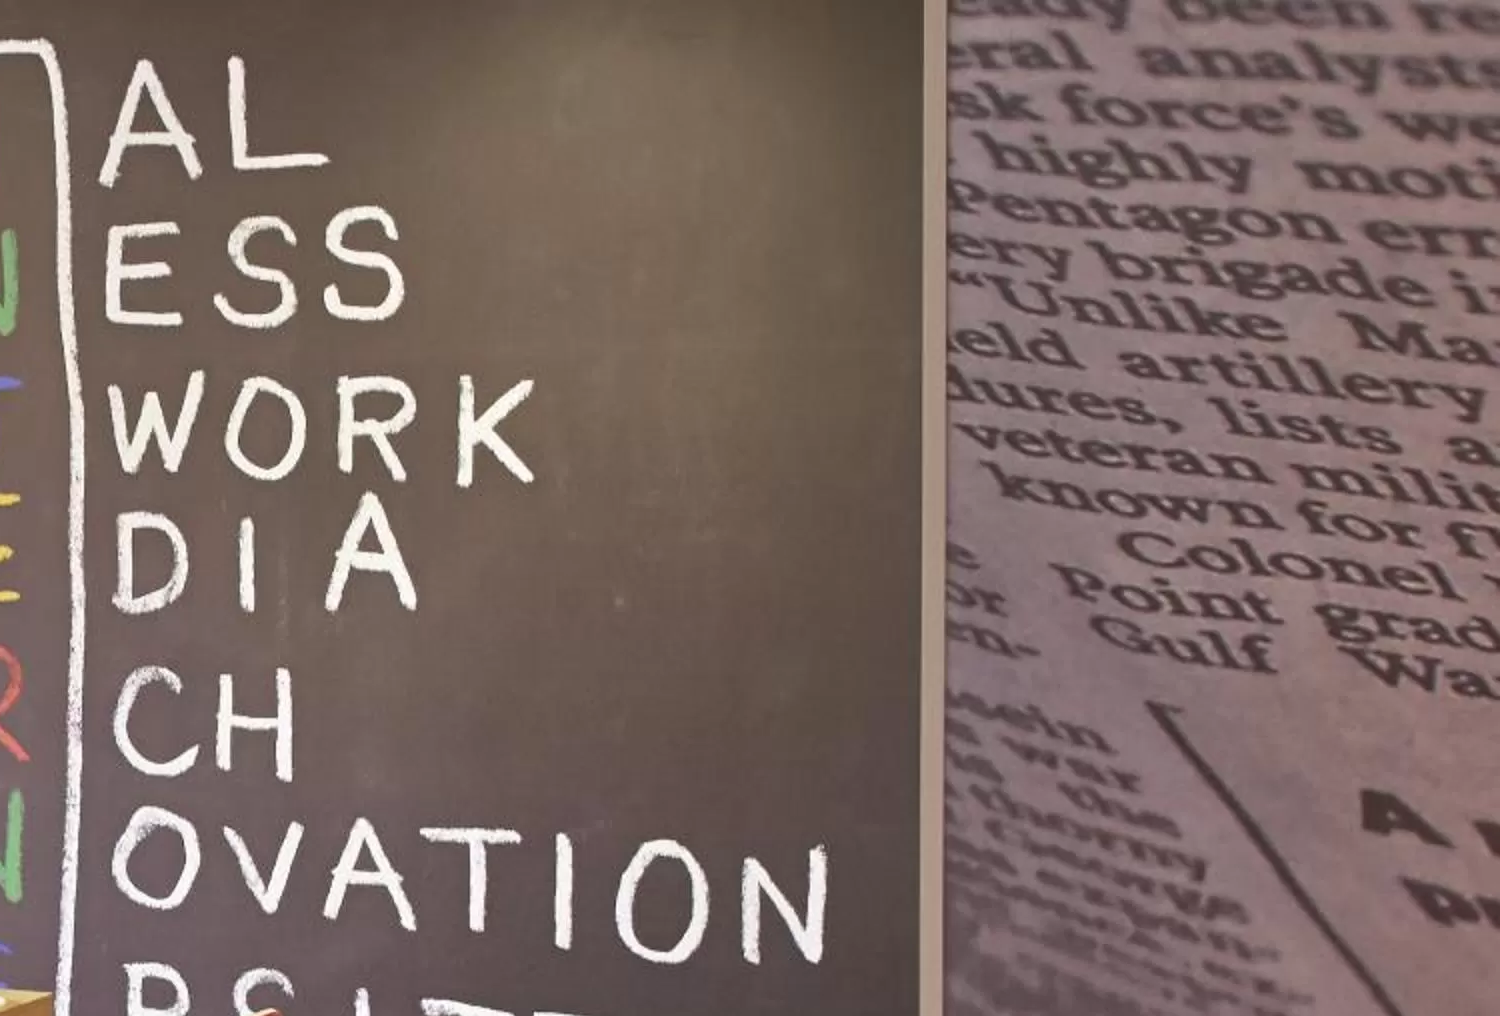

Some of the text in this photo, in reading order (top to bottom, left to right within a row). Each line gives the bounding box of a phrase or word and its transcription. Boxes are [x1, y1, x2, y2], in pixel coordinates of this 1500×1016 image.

[1056, 82, 1366, 141] force's
[970, 129, 1252, 196] highly
[947, 176, 1349, 247] Pentagon
[1083, 239, 1438, 309] brigade
[947, 320, 1488, 425] eld artillery
[1335, 309, 1500, 369] Ma
[953, 421, 1279, 486] veteran
[1207, 396, 1403, 455] lists
[980, 459, 1287, 531] known
[1296, 500, 1427, 551] for
[1047, 562, 1285, 626] Point
[1116, 531, 1468, 604] Colonel
[1089, 613, 1500, 702] Gulf Wa
